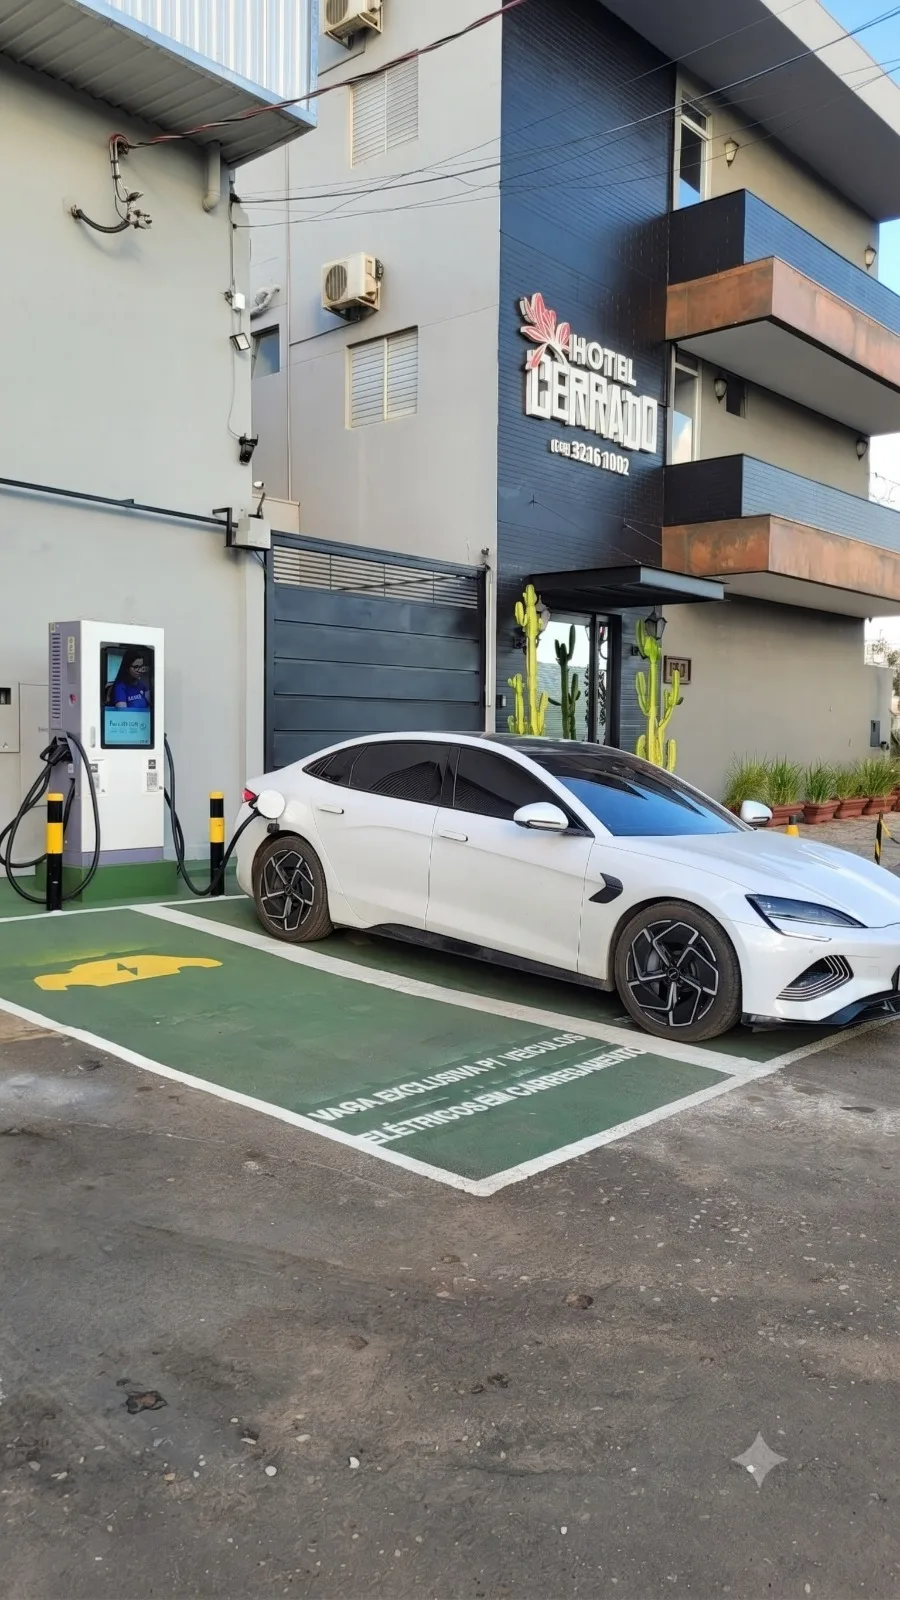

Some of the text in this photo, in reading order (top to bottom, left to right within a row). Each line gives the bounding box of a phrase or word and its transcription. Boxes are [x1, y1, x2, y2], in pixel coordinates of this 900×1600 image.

[569, 334, 637, 387] HOTEL
[525, 349, 658, 454] CERRADO
[307, 1097, 386, 1121] VAGA
[373, 1060, 488, 1102] EXCLUSIVA
[476, 1057, 507, 1071] P/
[357, 1046, 648, 1145] ELÉTRICOS EM CARREGAMENTO
